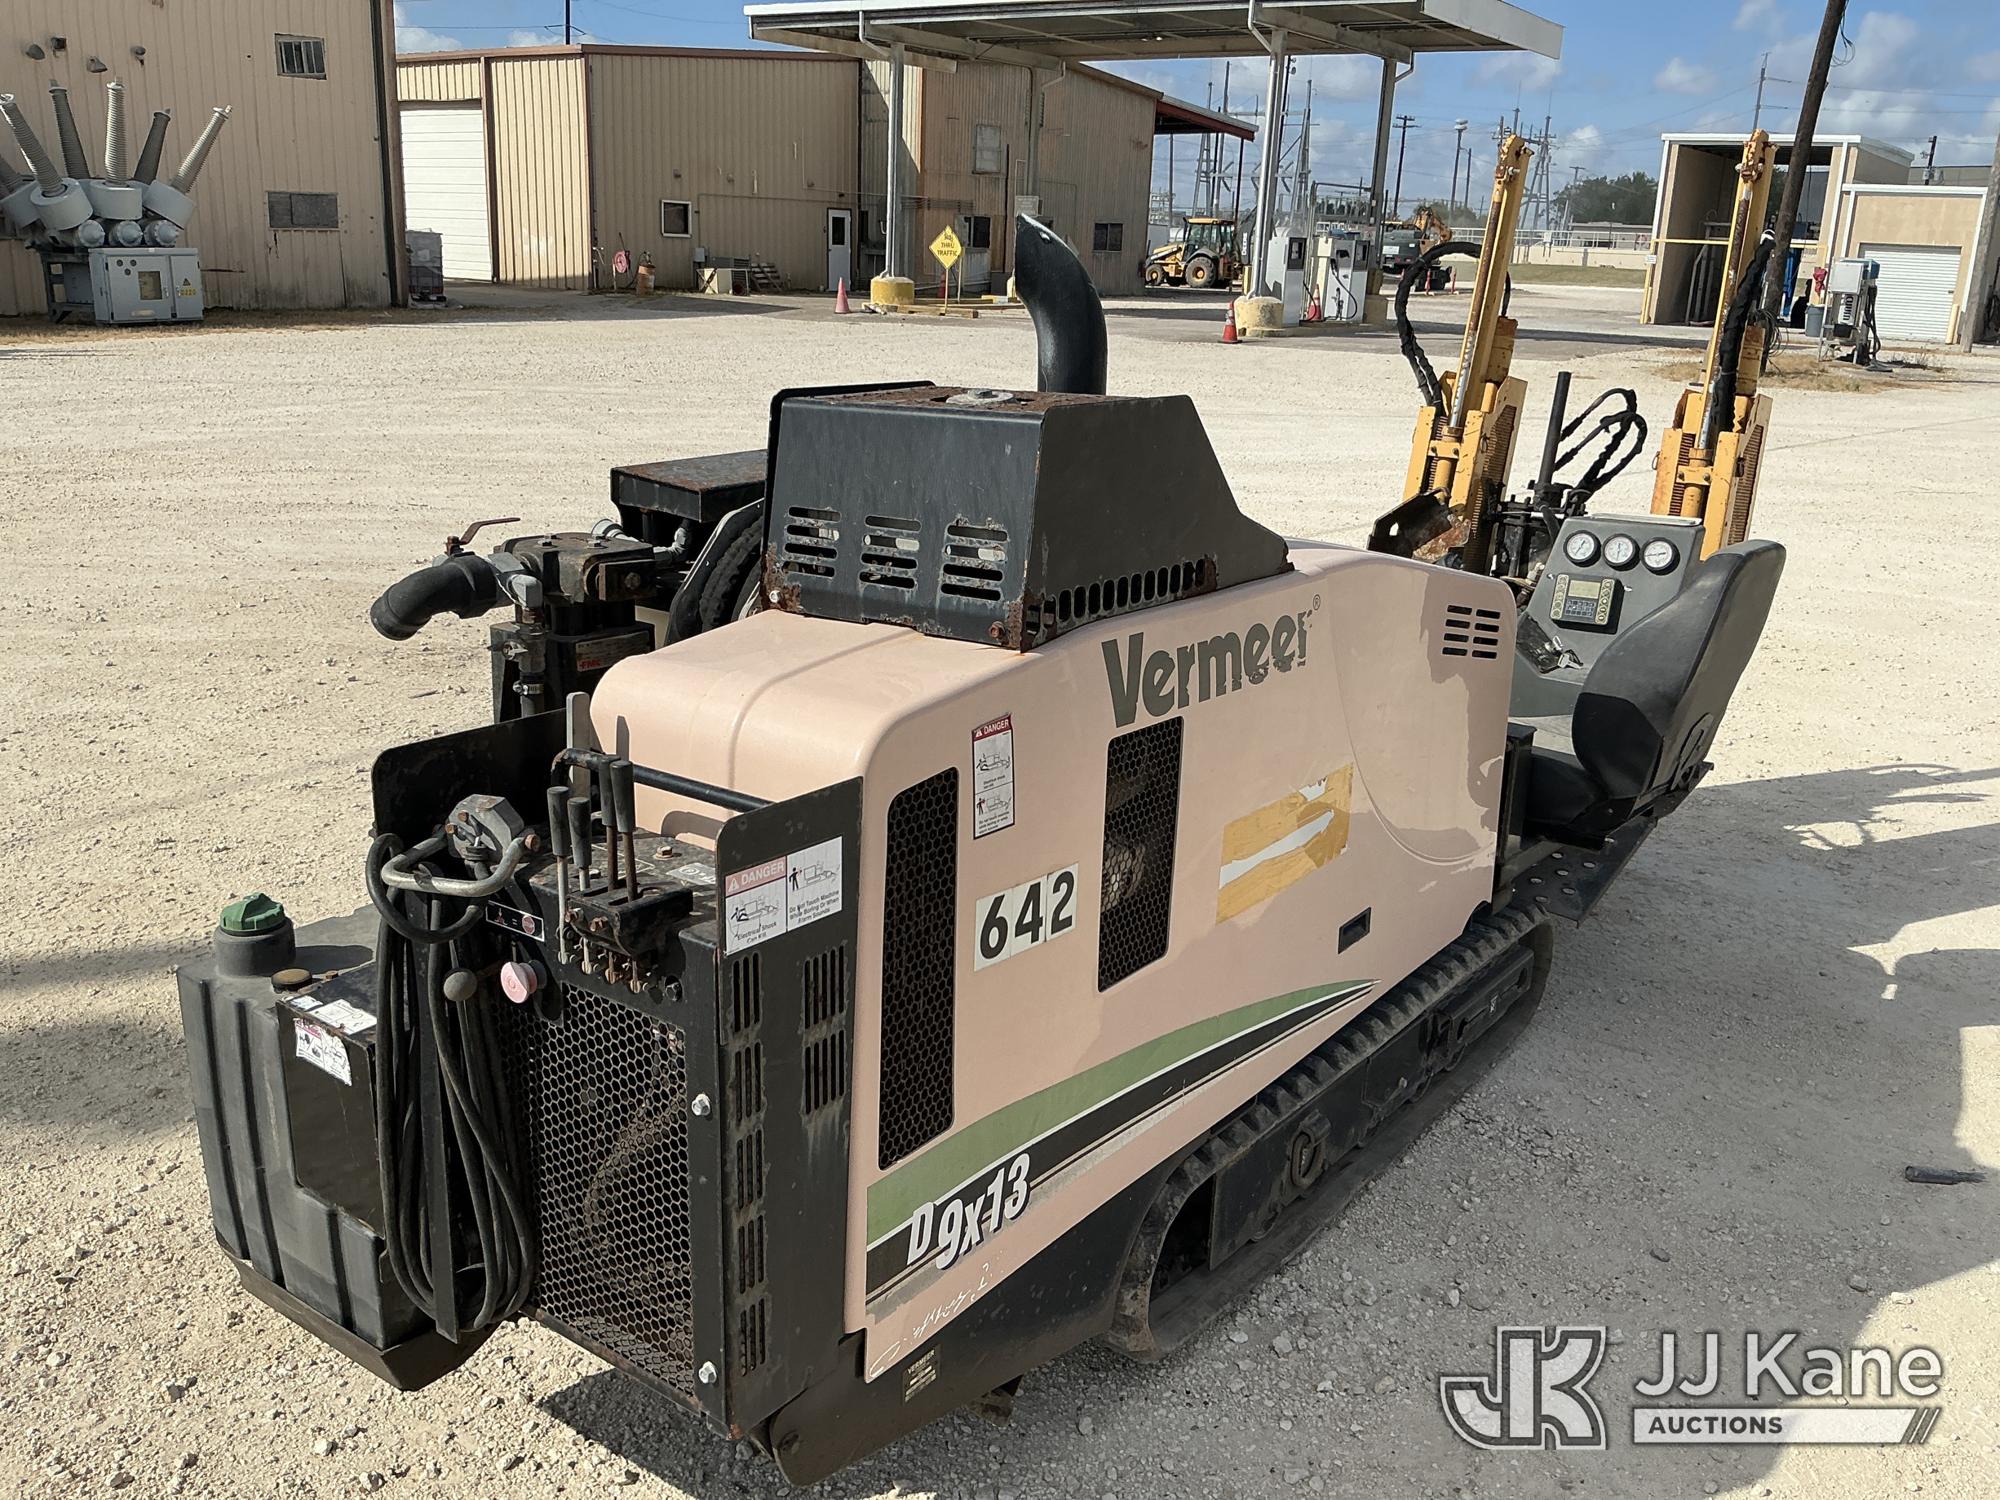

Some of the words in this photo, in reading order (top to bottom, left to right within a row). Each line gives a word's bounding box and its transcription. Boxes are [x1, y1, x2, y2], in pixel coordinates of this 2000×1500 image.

[1101, 609, 1313, 728] Vermeer
[983, 719, 1009, 734] DANGER
[741, 861, 785, 885] DANGER
[980, 871, 1075, 960] 642
